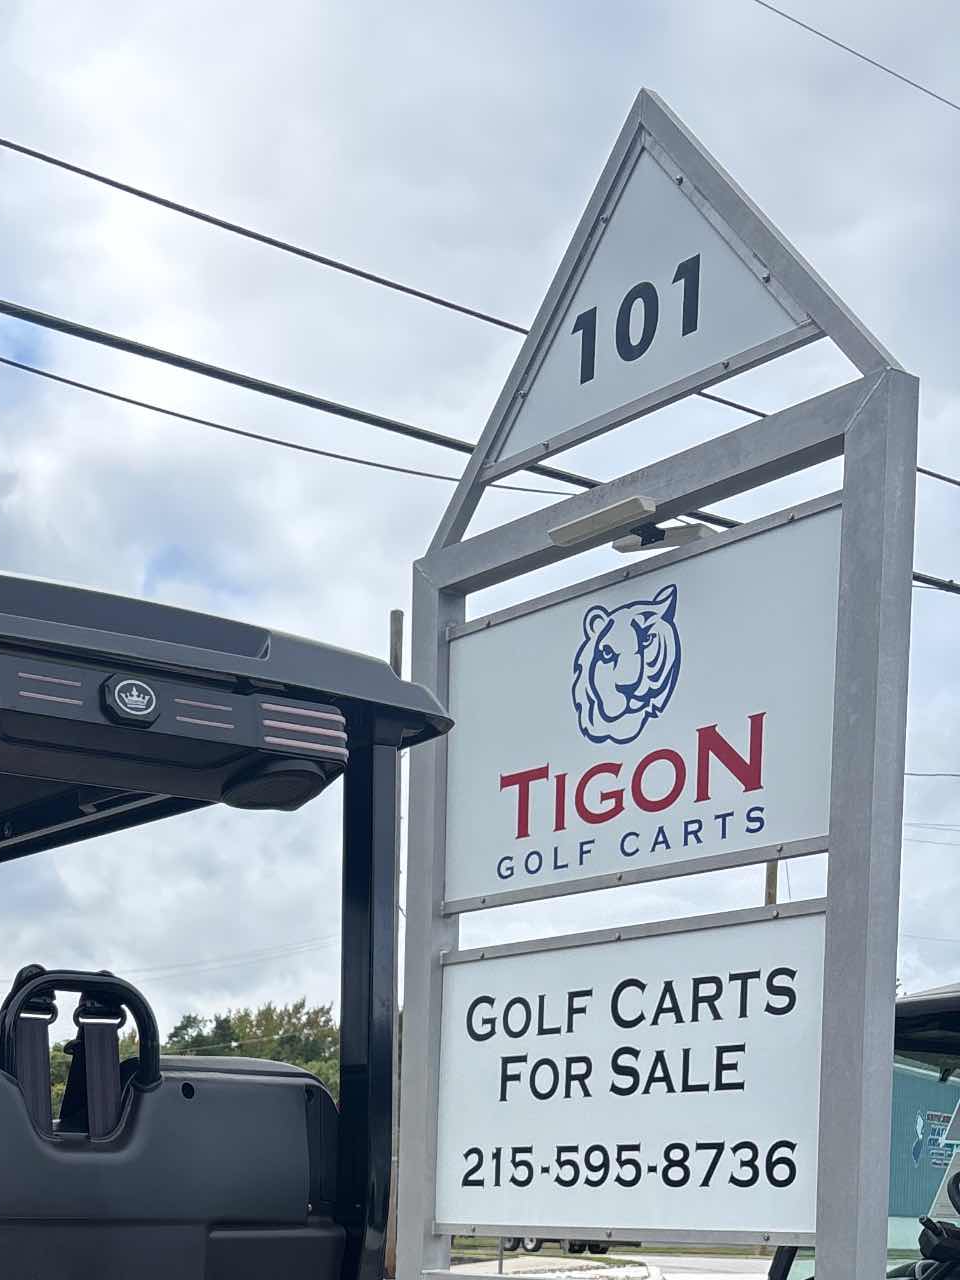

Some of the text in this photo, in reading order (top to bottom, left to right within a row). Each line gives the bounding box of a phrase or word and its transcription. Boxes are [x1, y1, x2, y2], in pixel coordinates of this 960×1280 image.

[569, 252, 701, 385] 101
[499, 711, 767, 840] TIGON
[496, 806, 766, 880] GOLF CARTS
[466, 967, 798, 1042] GOLF CARTS
[499, 1042, 746, 1102] FOR SALE
[461, 1139, 798, 1188] 215-595-8736
